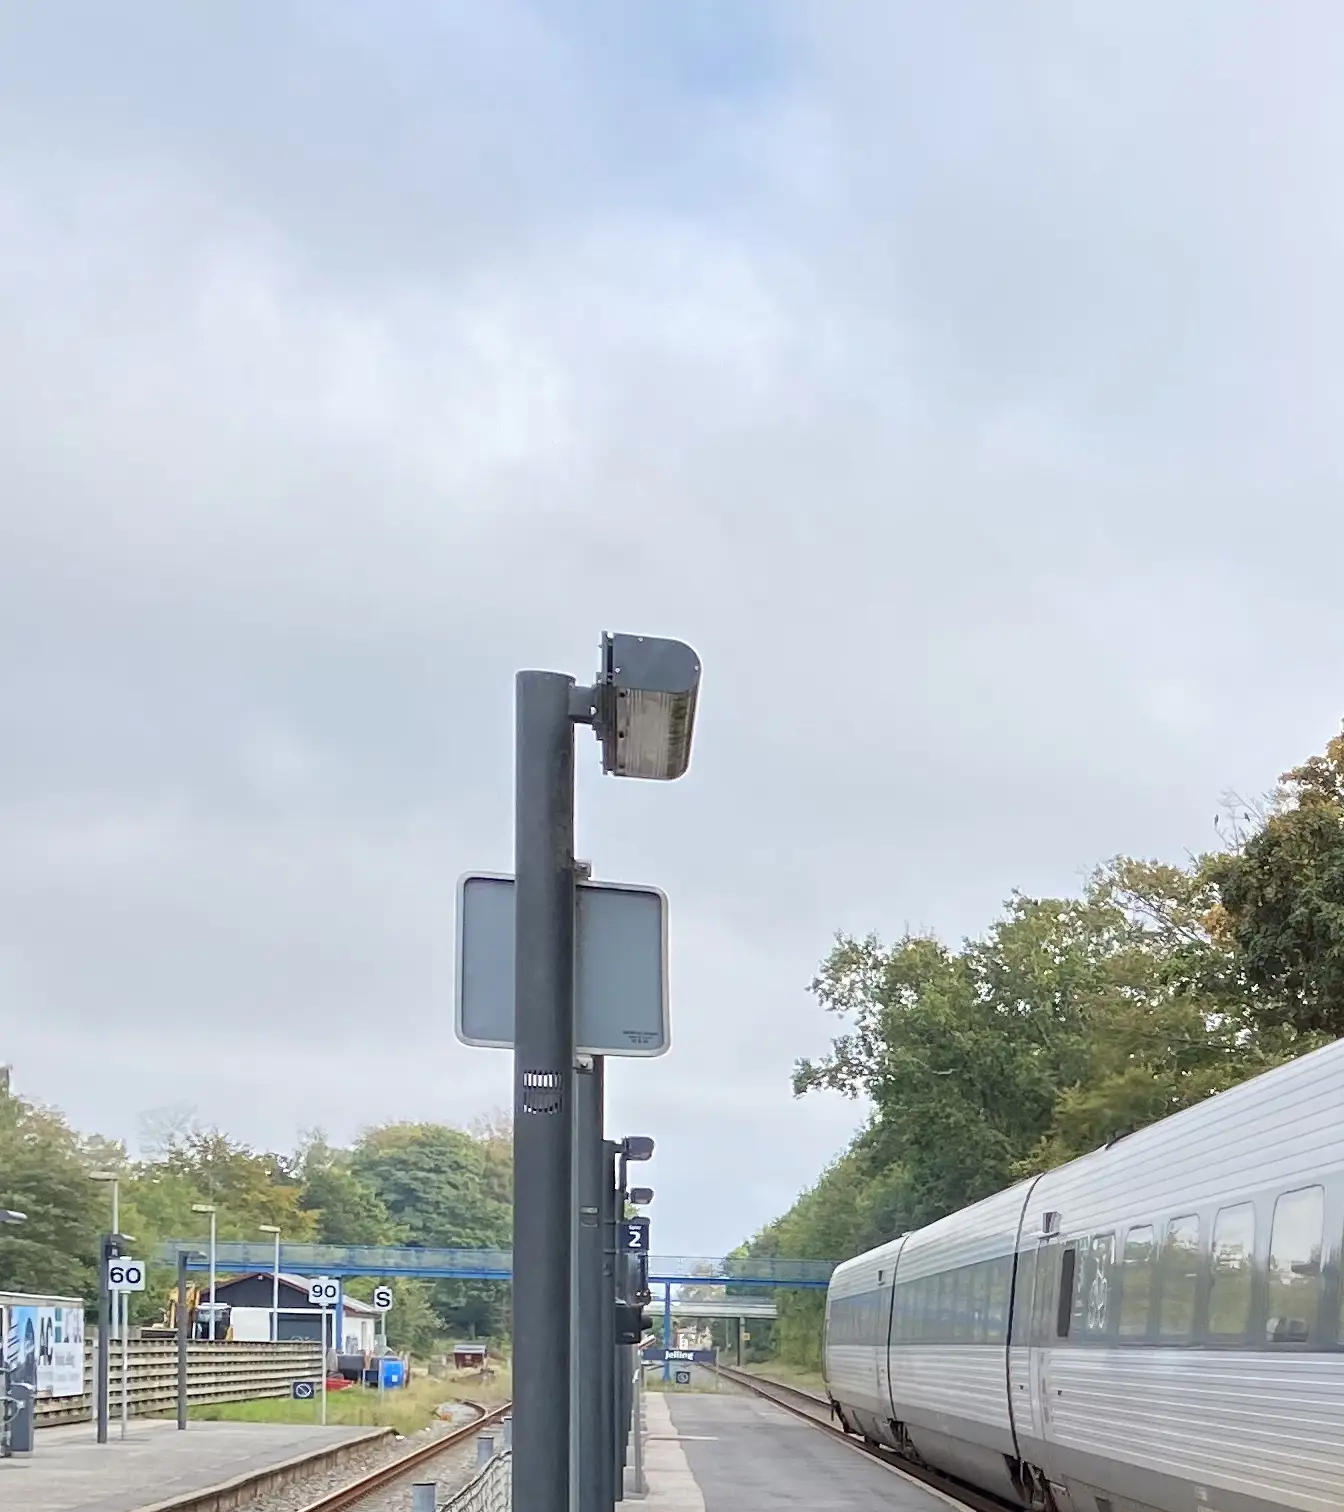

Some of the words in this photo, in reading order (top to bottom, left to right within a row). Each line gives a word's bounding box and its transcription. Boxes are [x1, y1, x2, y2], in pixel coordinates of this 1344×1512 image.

[628, 1231, 641, 1247] 2
[110, 1267, 141, 1283] 60
[312, 1284, 336, 1298] 90
[376, 1291, 390, 1307] S
[665, 1350, 694, 1360] Jelling
